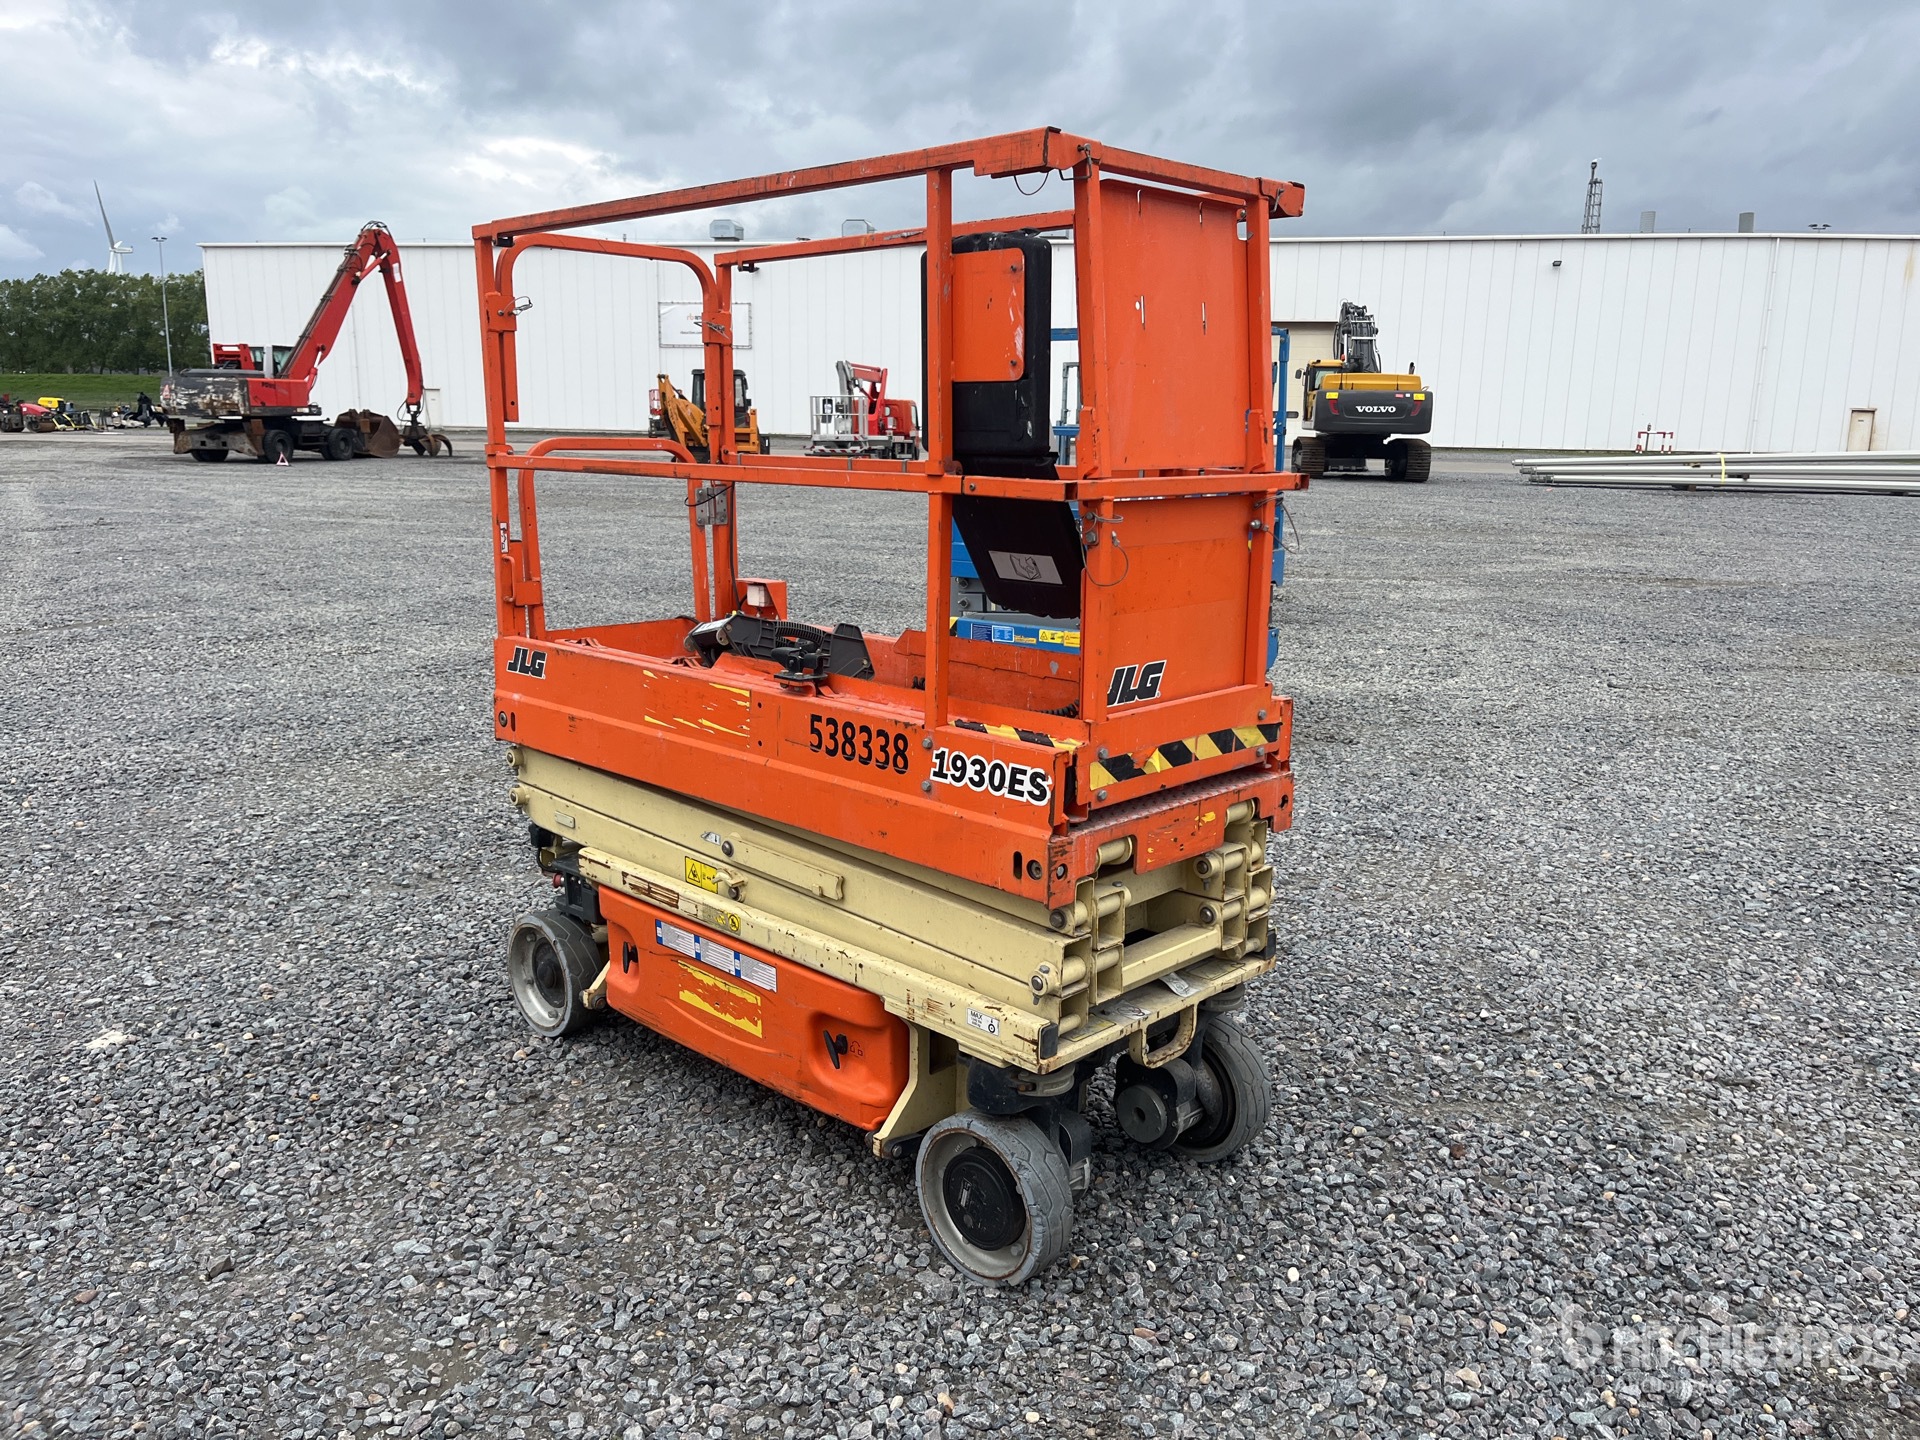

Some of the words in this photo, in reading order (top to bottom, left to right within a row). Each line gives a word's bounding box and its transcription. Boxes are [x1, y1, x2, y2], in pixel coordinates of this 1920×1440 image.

[1355, 405, 1397, 413] VOLVO
[507, 646, 547, 679] JLG
[809, 713, 909, 775] 538338
[931, 748, 1051, 804] 1930ES
